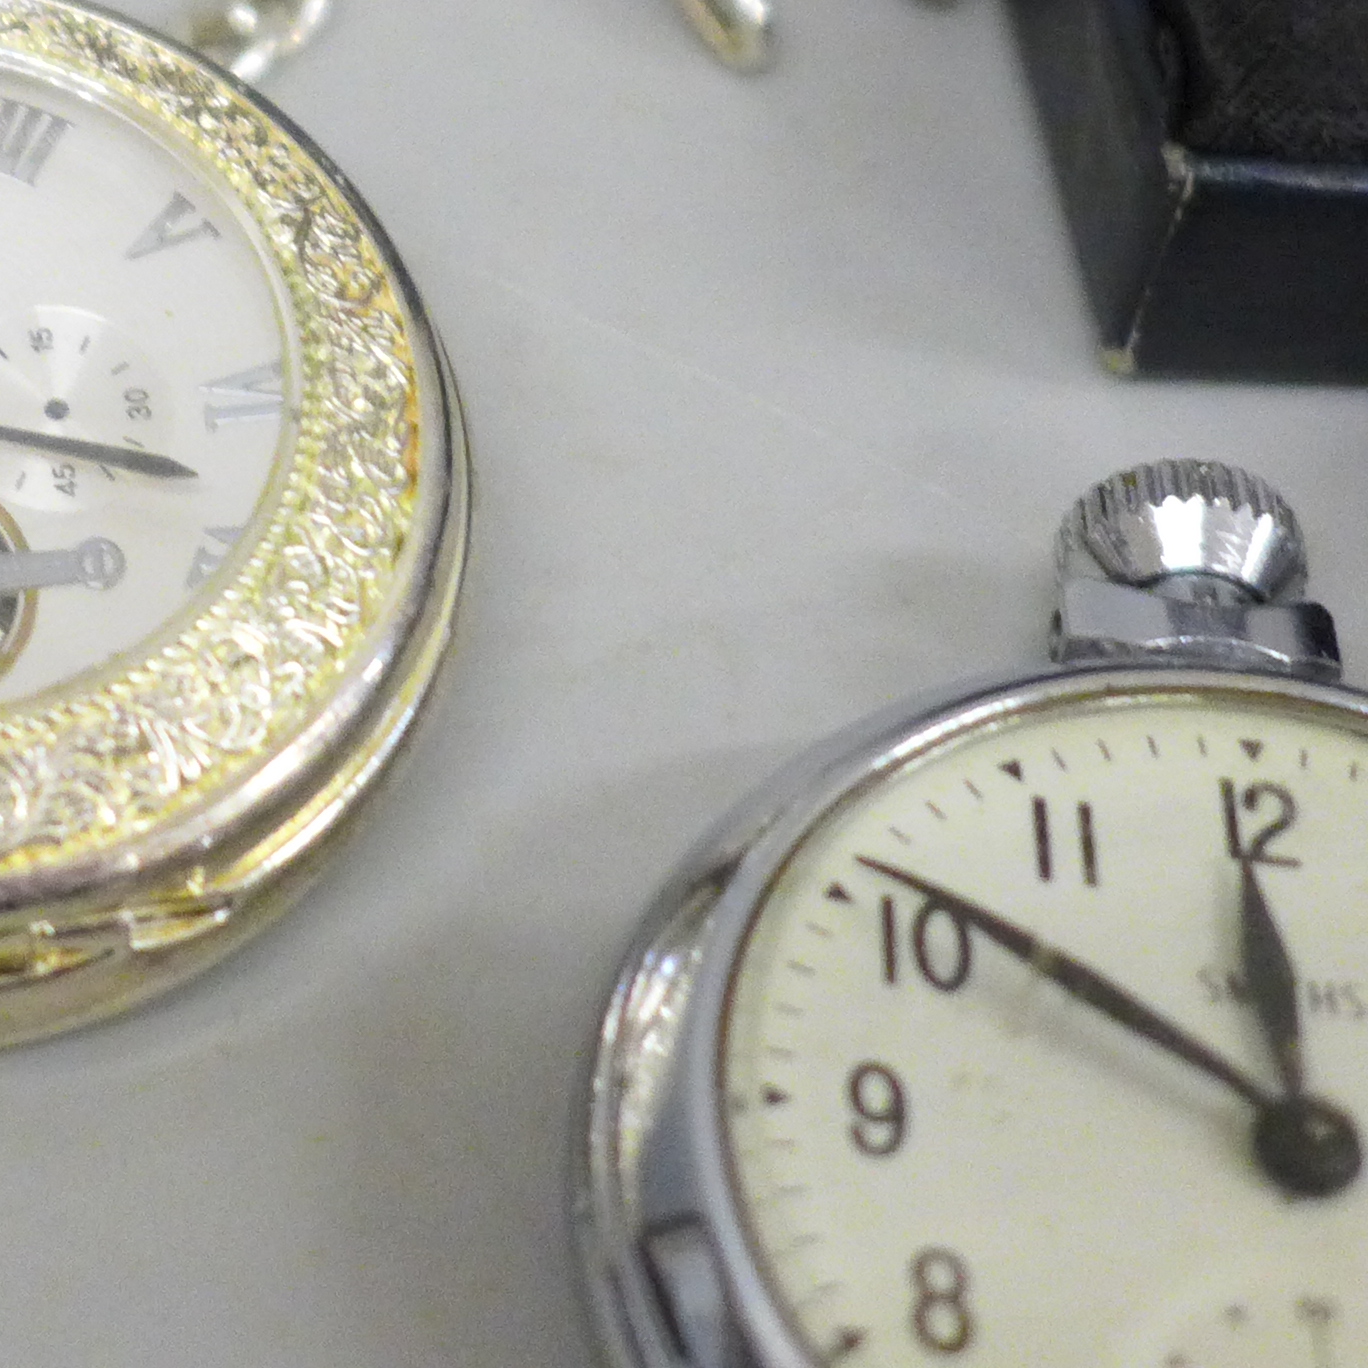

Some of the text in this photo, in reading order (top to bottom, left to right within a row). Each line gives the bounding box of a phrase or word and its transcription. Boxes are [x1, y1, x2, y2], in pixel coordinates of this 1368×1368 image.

[27, 327, 54, 353] 15
[122, 387, 152, 420] 30
[52, 463, 77, 498] 45
[1032, 795, 1100, 888] 11
[1218, 777, 1302, 868] 12
[880, 893, 972, 993] 10
[848, 1060, 907, 1157] 9
[910, 1247, 975, 1354] 8
